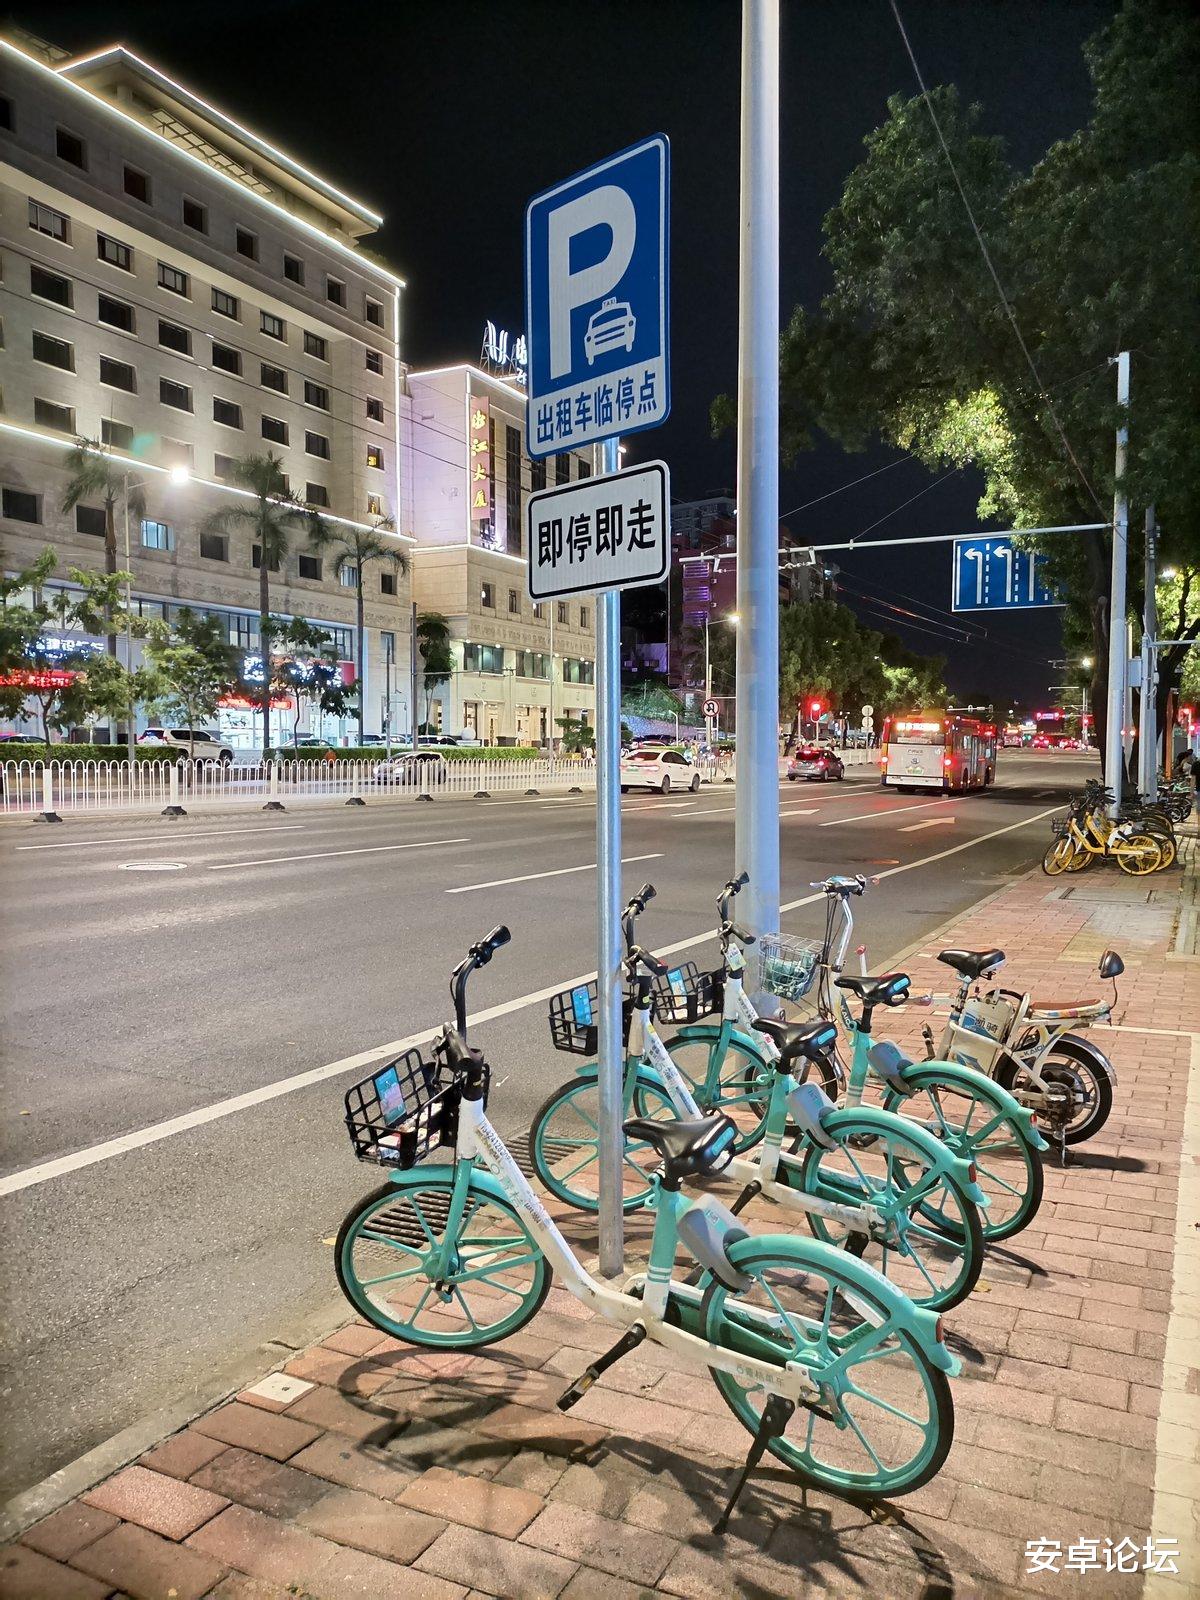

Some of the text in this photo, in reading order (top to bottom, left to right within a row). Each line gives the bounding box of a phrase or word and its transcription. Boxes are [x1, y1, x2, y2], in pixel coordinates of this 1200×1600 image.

[548, 184, 637, 380] P
[603, 298, 616, 308] TAXI
[537, 371, 657, 442] 出租车临停点
[538, 498, 656, 569] 即停即走
